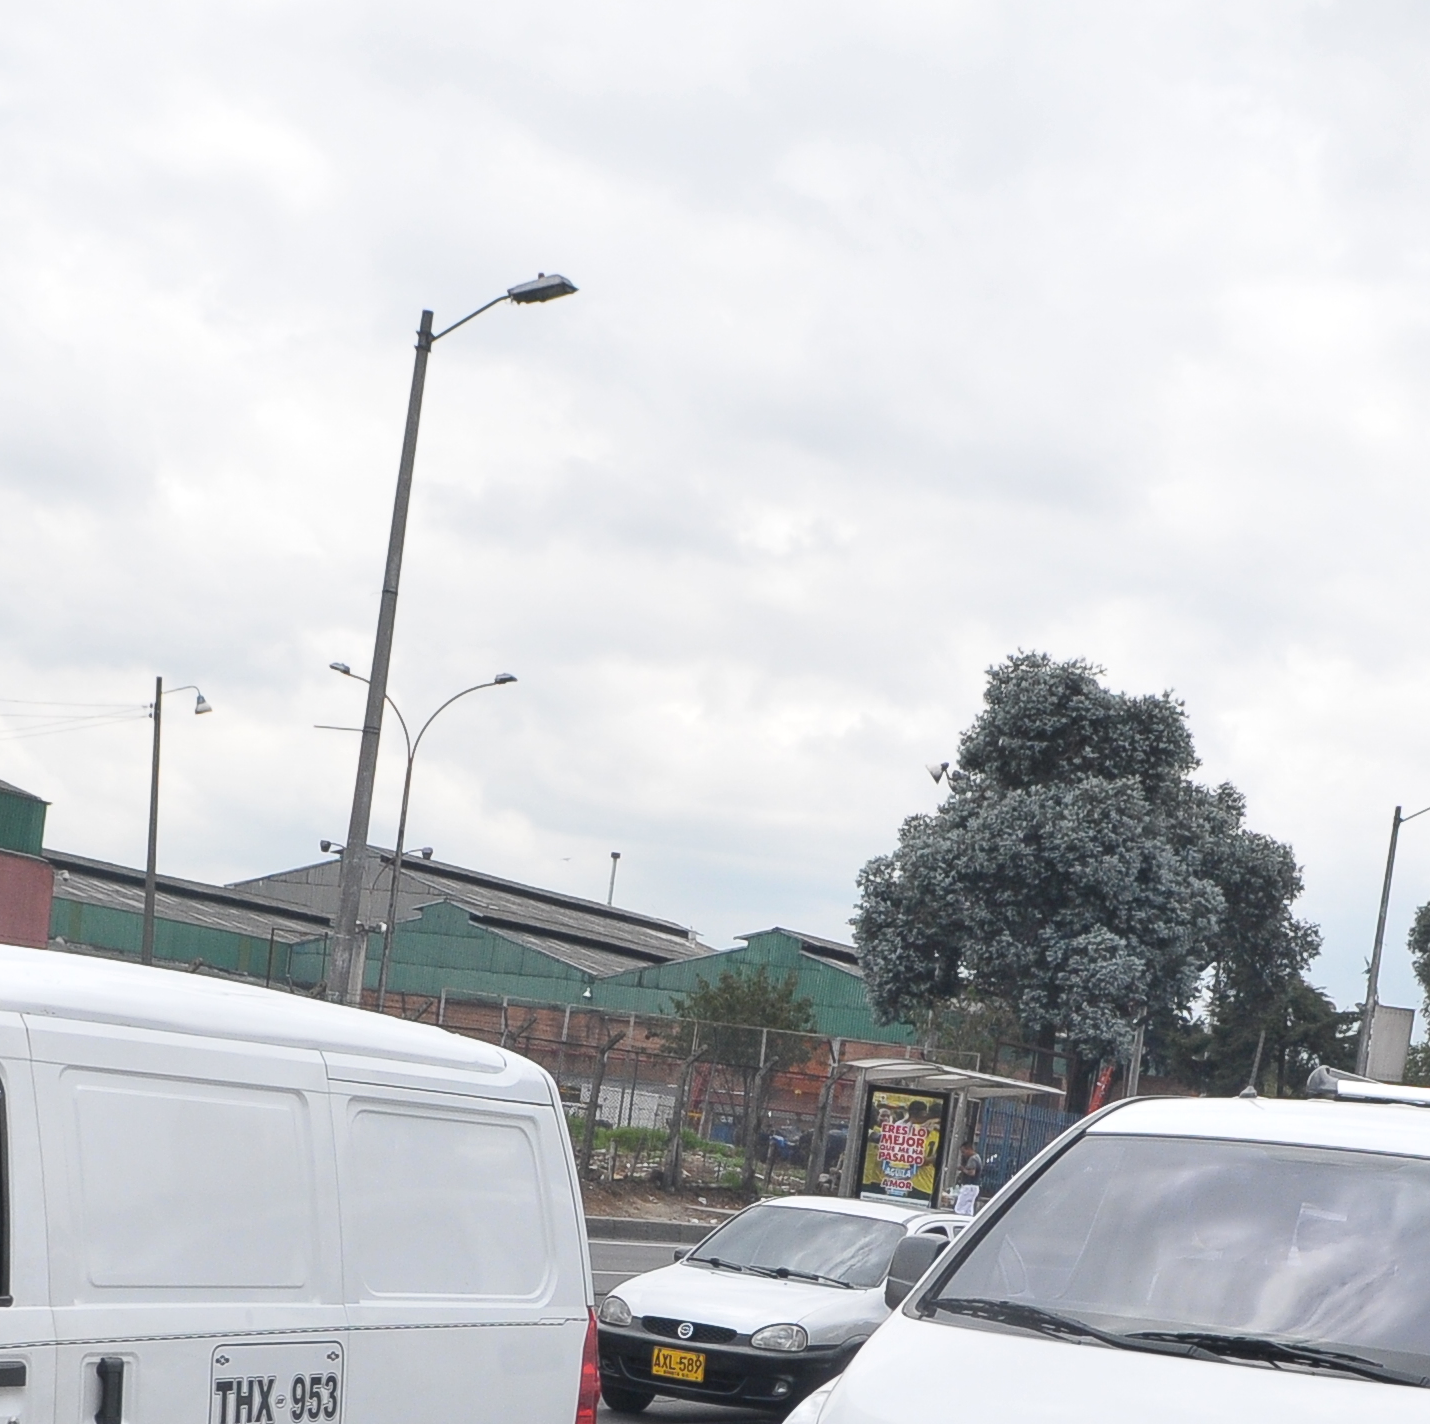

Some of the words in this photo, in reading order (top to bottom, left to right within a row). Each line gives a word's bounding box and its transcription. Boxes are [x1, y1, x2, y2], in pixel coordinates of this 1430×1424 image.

[882, 1123, 908, 1135] ERES
[912, 1127, 927, 1137] LO
[881, 1134, 924, 1148] MEJOR
[879, 1144, 895, 1152] QUE
[878, 1152, 923, 1164] PASADO
[882, 1179, 912, 1189] AMOR
[654, 1350, 702, 1374] AXL-589
